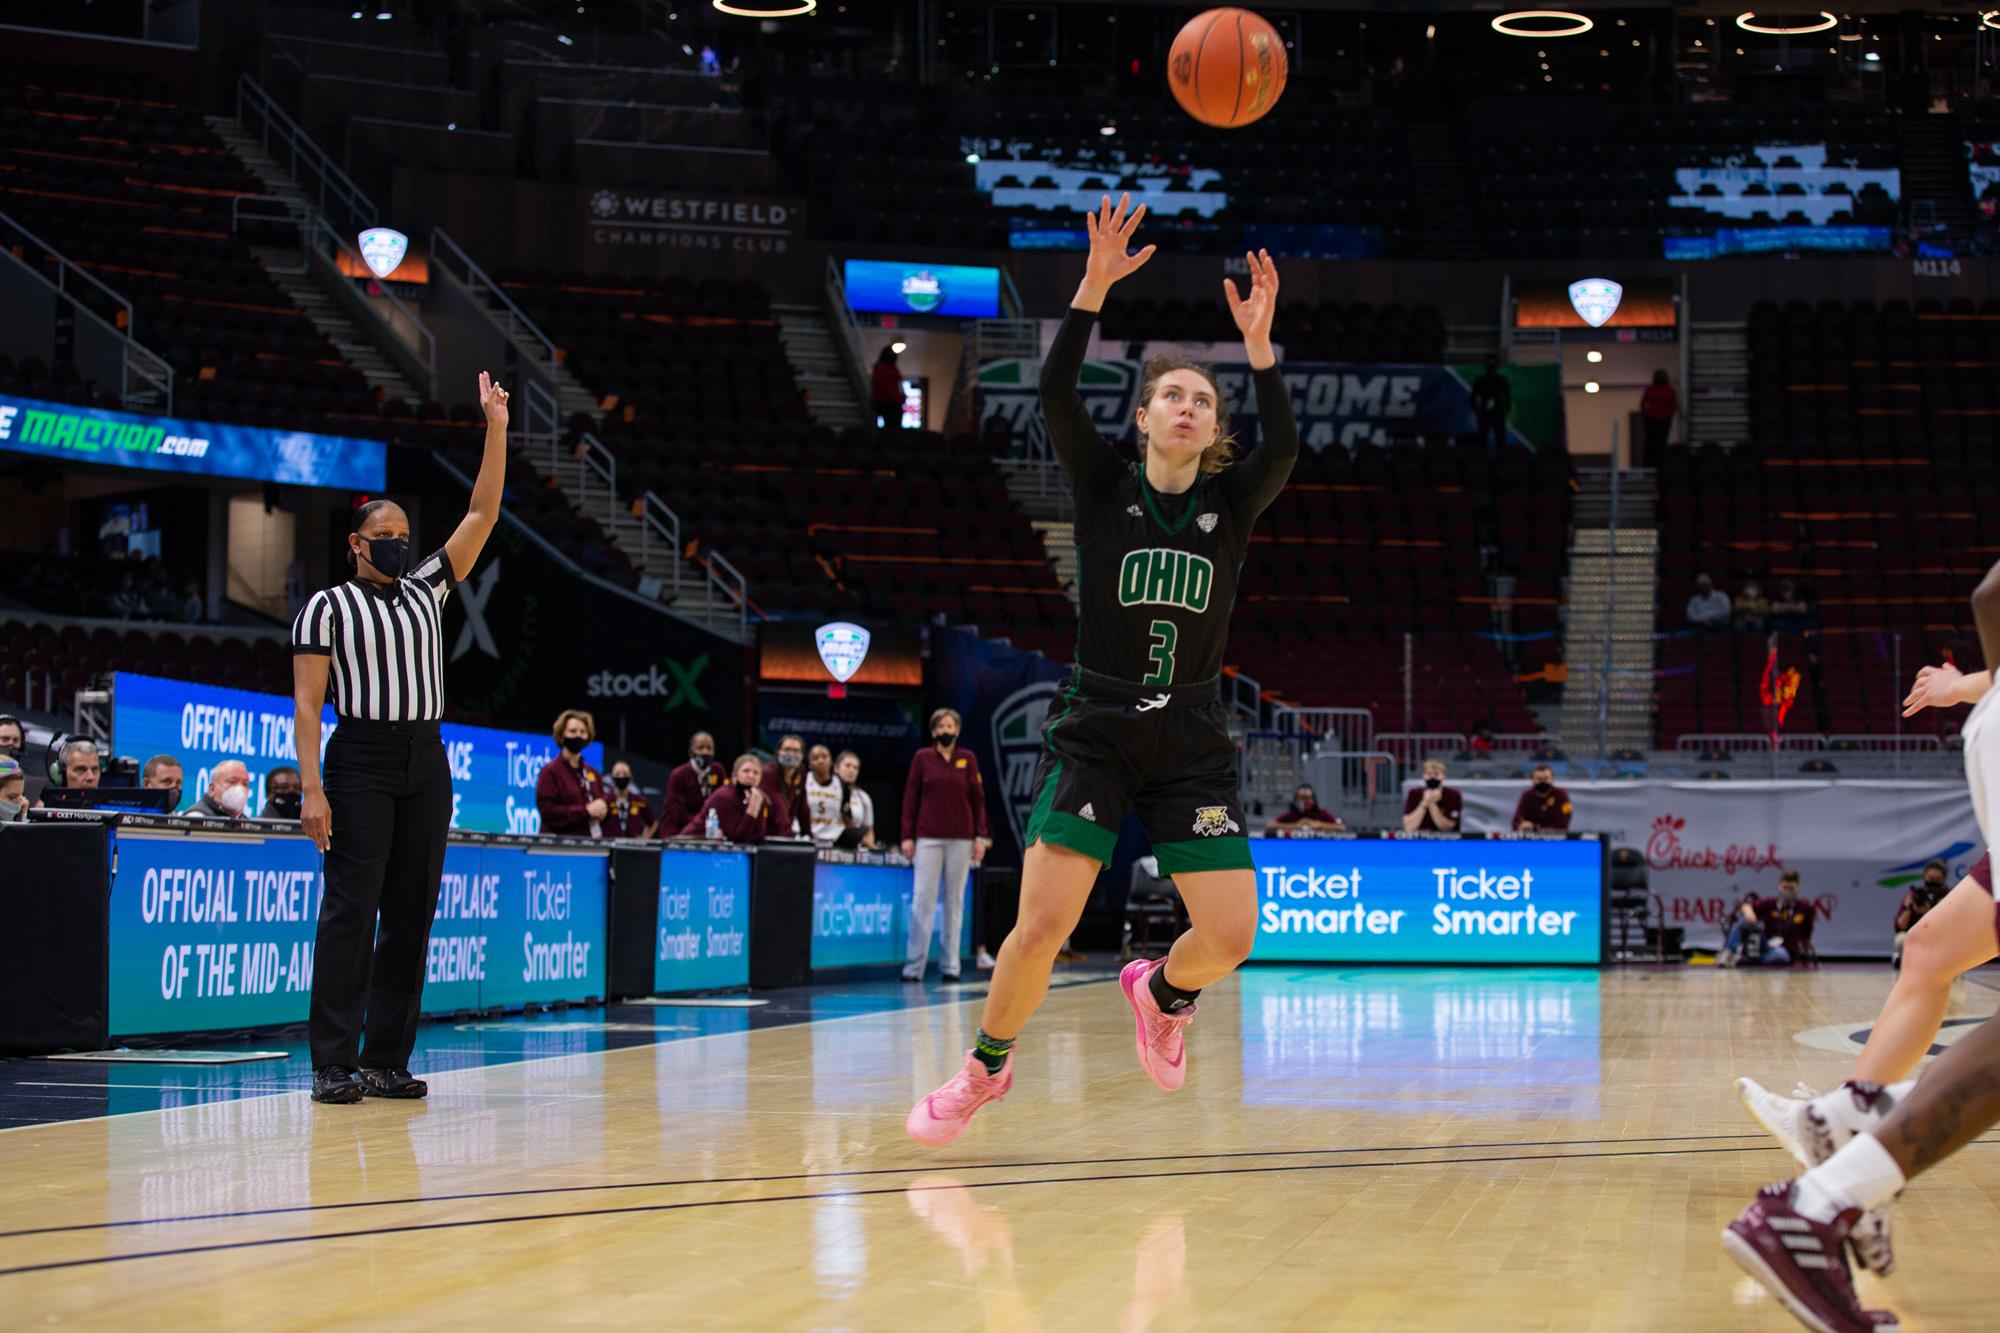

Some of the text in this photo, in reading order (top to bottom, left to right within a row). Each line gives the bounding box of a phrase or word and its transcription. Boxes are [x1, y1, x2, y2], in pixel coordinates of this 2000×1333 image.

[624, 197, 788, 225] WESTFIELD
[593, 230, 788, 253] CHAMPIONS CLUB
[1914, 259, 1960, 276] M114
[1215, 372, 1422, 417] ELCOME
[1119, 548, 1213, 613] OHIO
[1143, 620, 1178, 686] 3
[181, 702, 255, 756] OFFICIAL
[260, 712, 298, 760] TICK
[142, 868, 238, 923] OFFICIAL
[245, 870, 314, 923] TICKET
[523, 870, 572, 921] Ticket
[1261, 866, 1363, 899] Ticket
[1432, 867, 1535, 900] Ticket
[661, 886, 691, 920] Ticket
[708, 886, 735, 919] Ticket
[1261, 901, 1406, 935] Smarter
[1432, 903, 1578, 936] Smarter
[523, 930, 591, 983] Smarter
[660, 926, 701, 961] Smarter
[707, 925, 744, 958] Smarter
[161, 936, 488, 1000] OF THE MID-AM ERENCE
